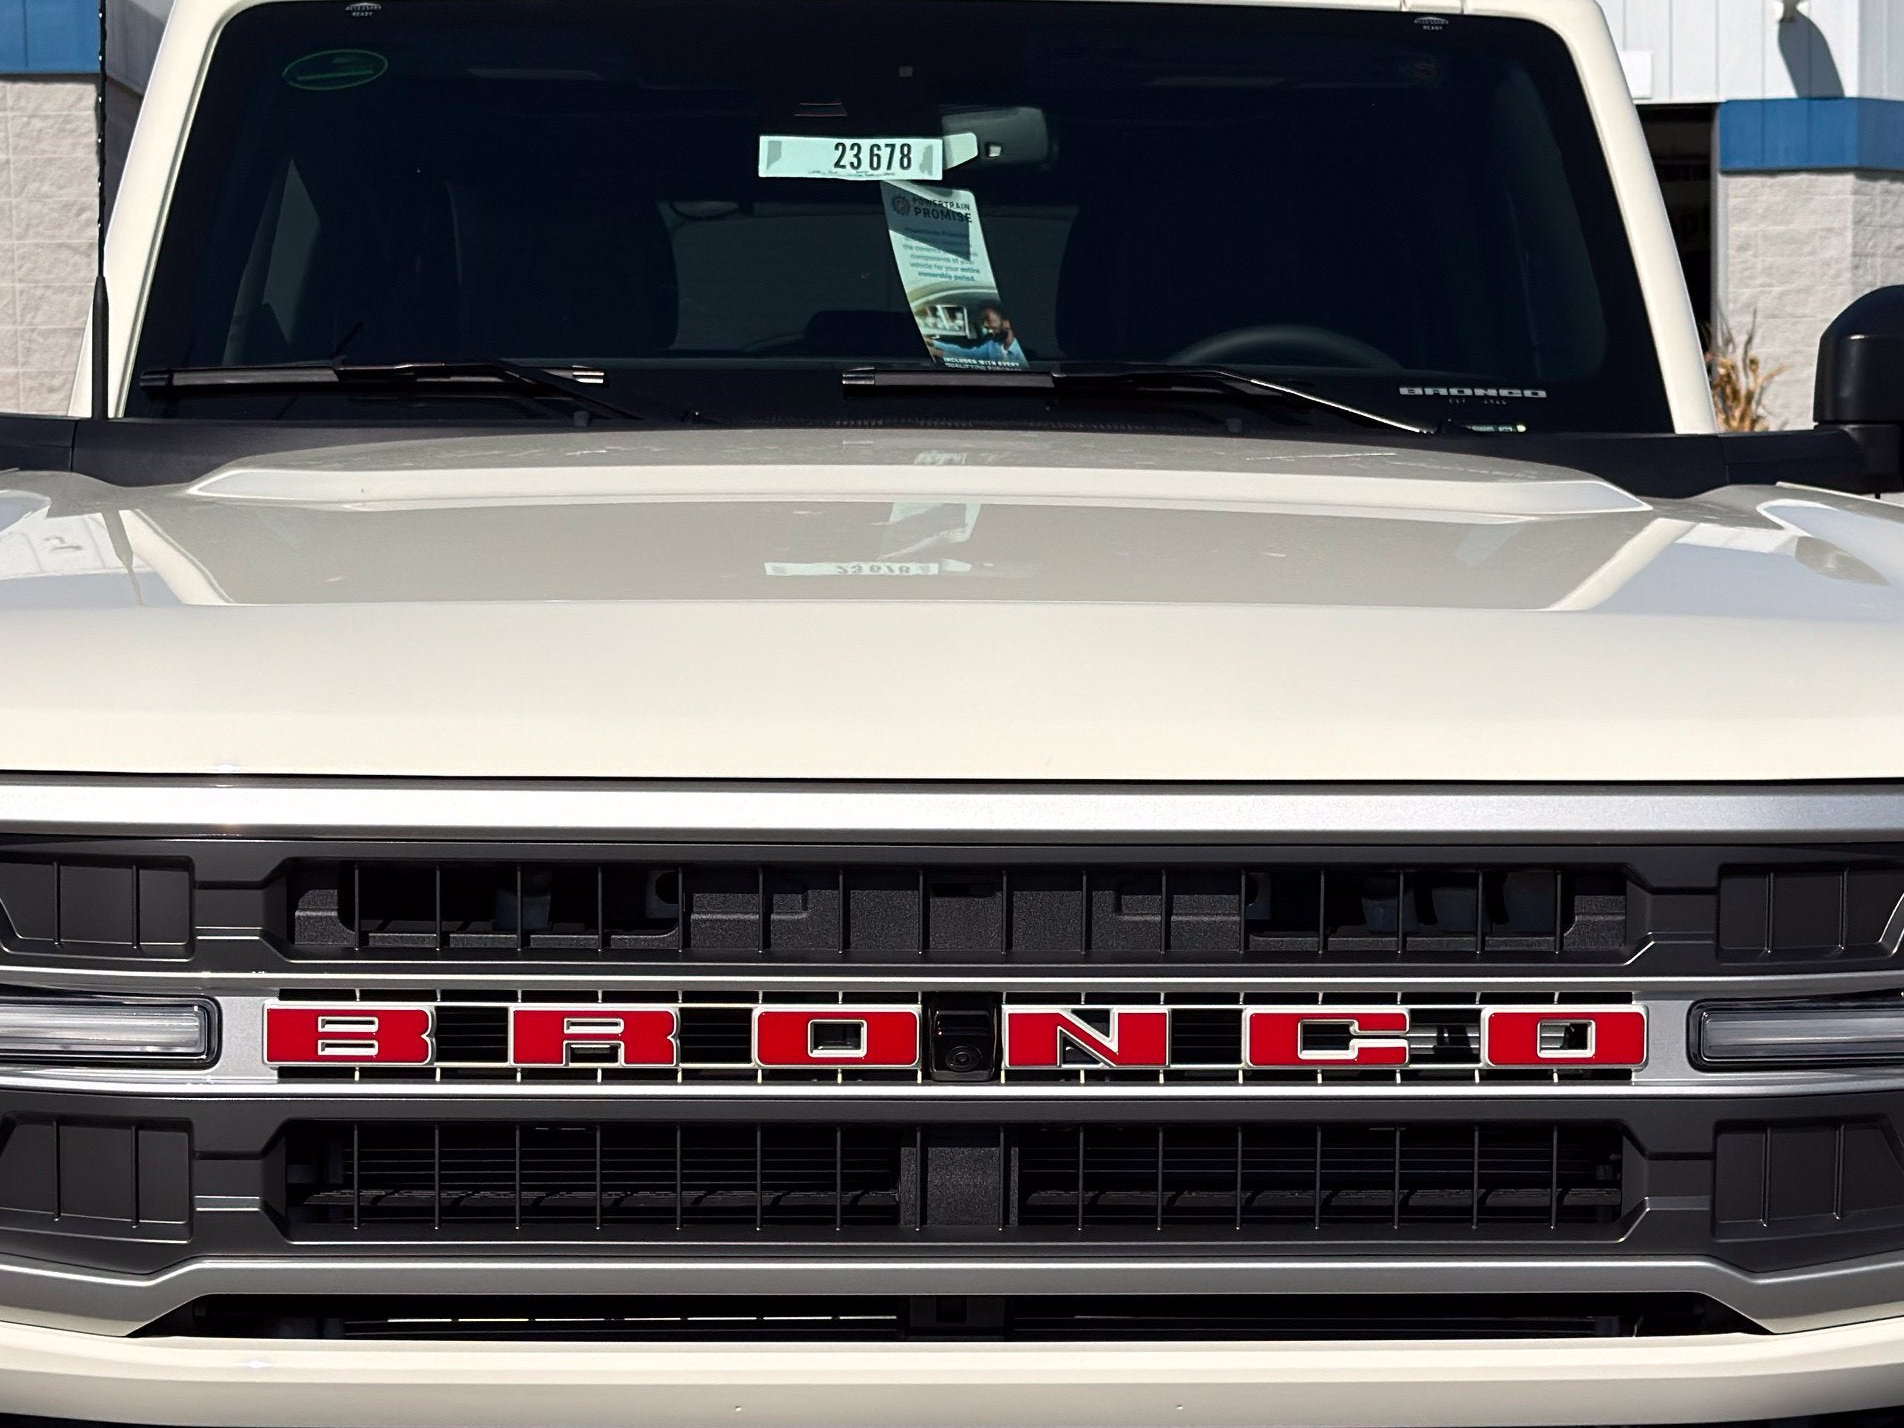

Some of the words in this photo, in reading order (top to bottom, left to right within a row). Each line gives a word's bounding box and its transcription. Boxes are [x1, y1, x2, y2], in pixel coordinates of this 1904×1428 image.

[912, 198, 970, 212] POWERTRAIN
[913, 206, 973, 223] PROMISE
[1399, 386, 1547, 398] BRONCO
[263, 1002, 1648, 1070] BRONCO
